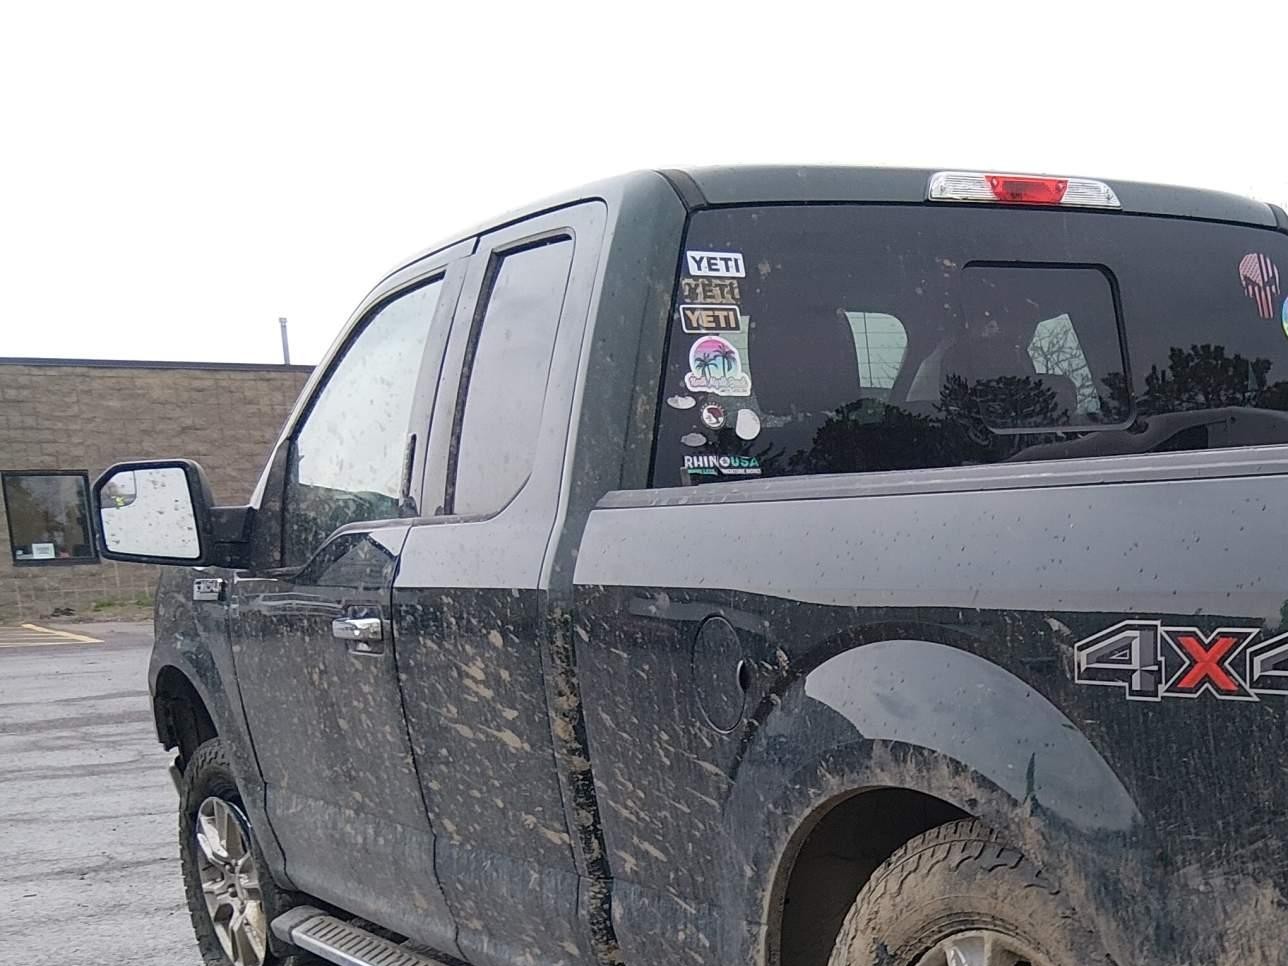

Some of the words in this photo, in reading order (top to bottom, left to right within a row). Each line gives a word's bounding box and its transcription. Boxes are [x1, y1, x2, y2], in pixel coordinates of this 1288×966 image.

[690, 255, 741, 273] YETI
[684, 281, 739, 302] YETI
[684, 310, 736, 328] YETI
